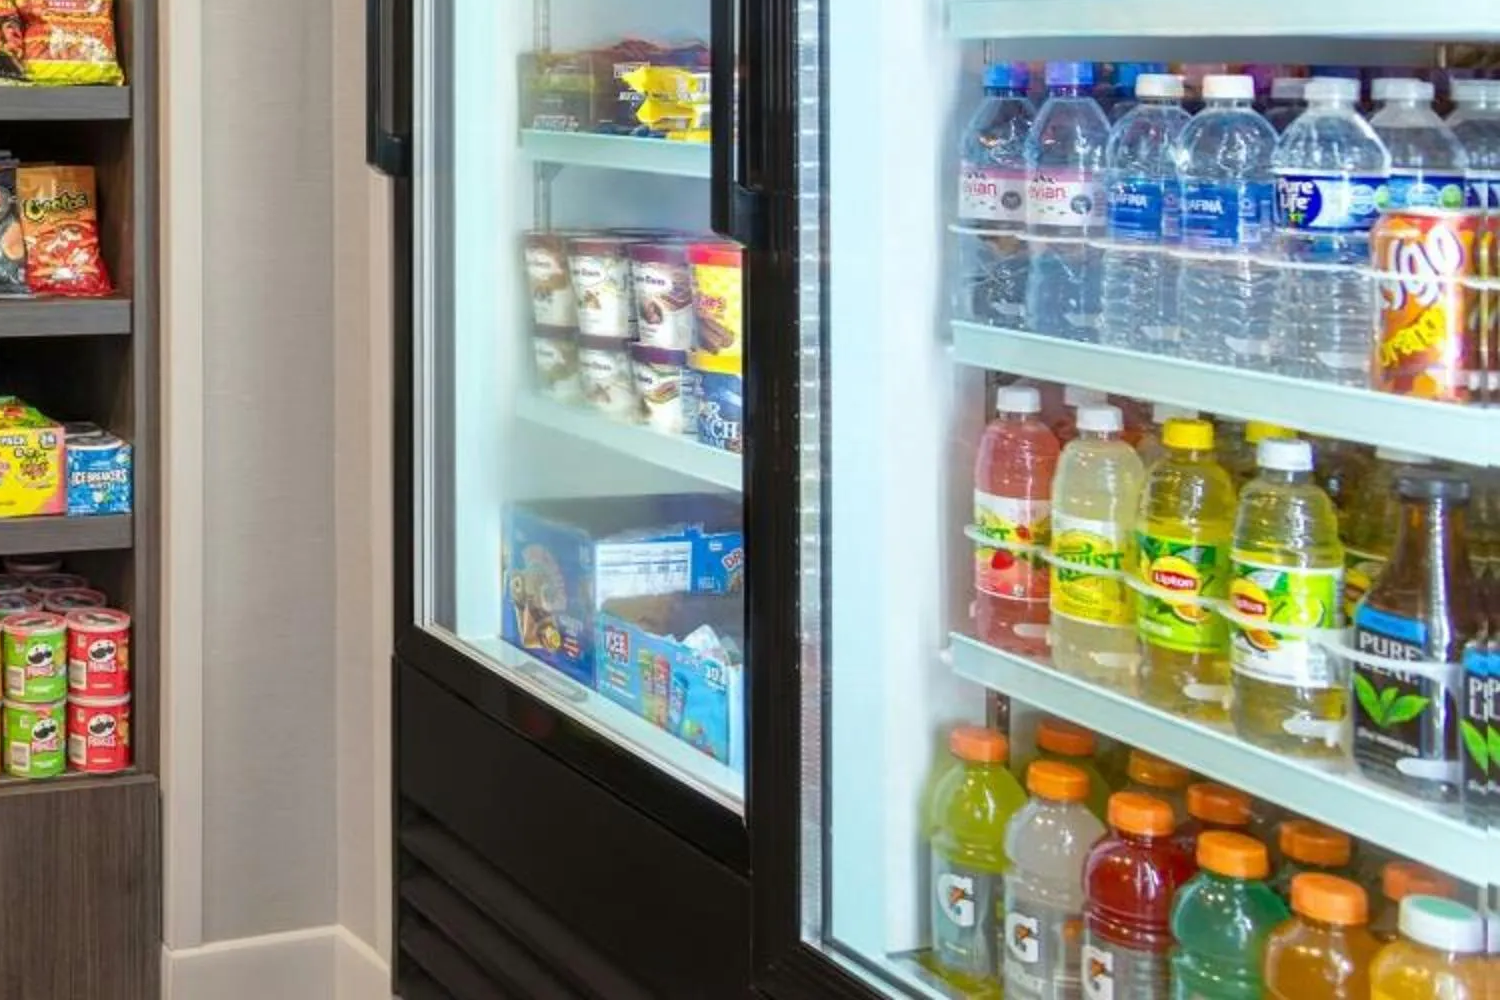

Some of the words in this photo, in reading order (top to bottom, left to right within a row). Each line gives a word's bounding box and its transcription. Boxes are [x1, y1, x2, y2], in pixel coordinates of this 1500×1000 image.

[1278, 177, 1314, 195] Pure
[1154, 572, 1195, 590] Lipton
[1359, 631, 1419, 663] PURE
